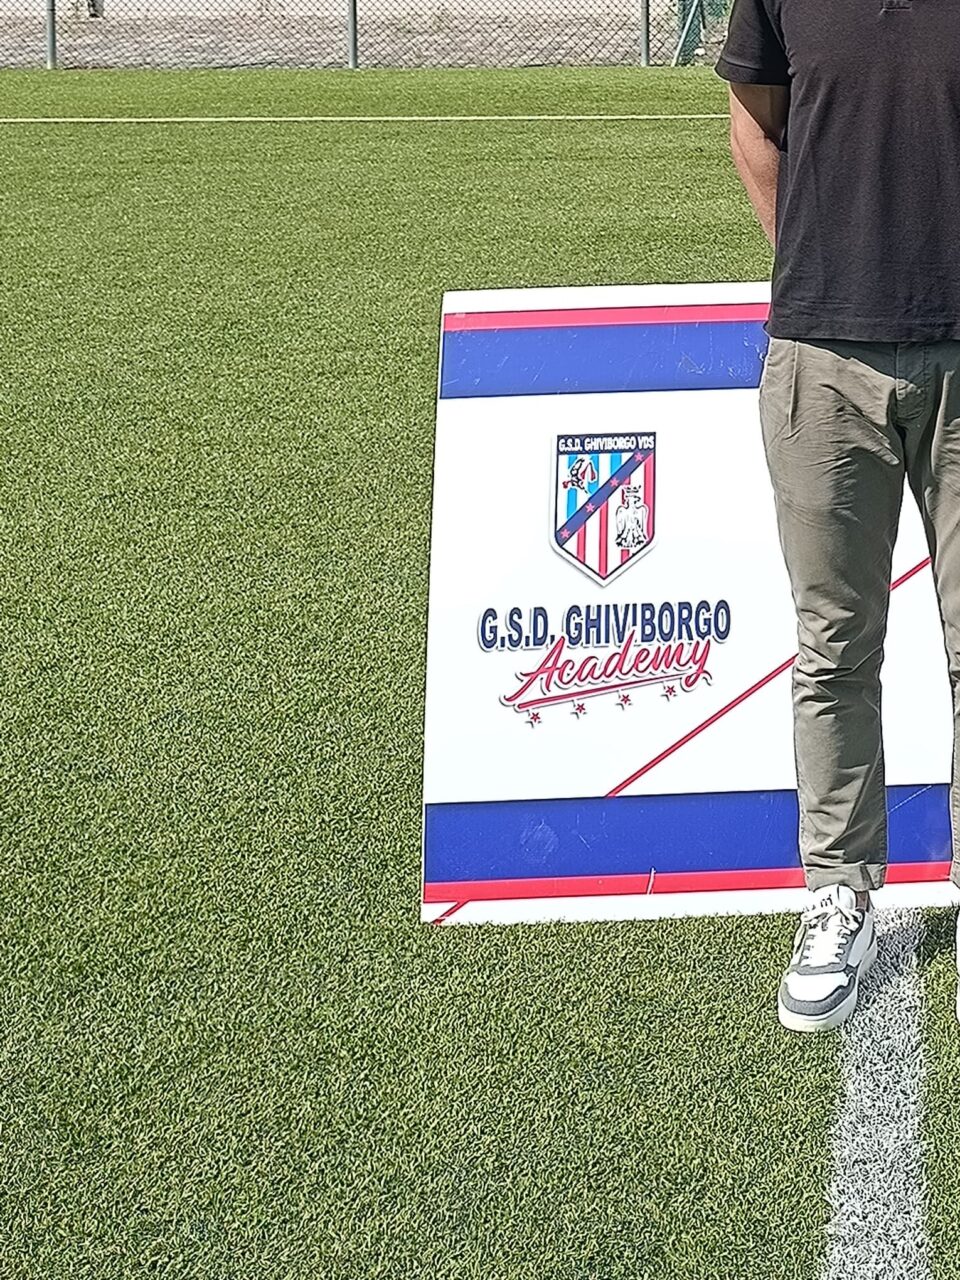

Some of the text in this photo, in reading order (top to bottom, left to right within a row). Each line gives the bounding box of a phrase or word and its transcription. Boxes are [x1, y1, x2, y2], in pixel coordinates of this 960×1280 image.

[558, 435, 655, 452] G.S.D. GHIVIBORGO VDS
[480, 599, 732, 649] G.S.D. GHIVIBORGO
[503, 630, 712, 702] Academy
